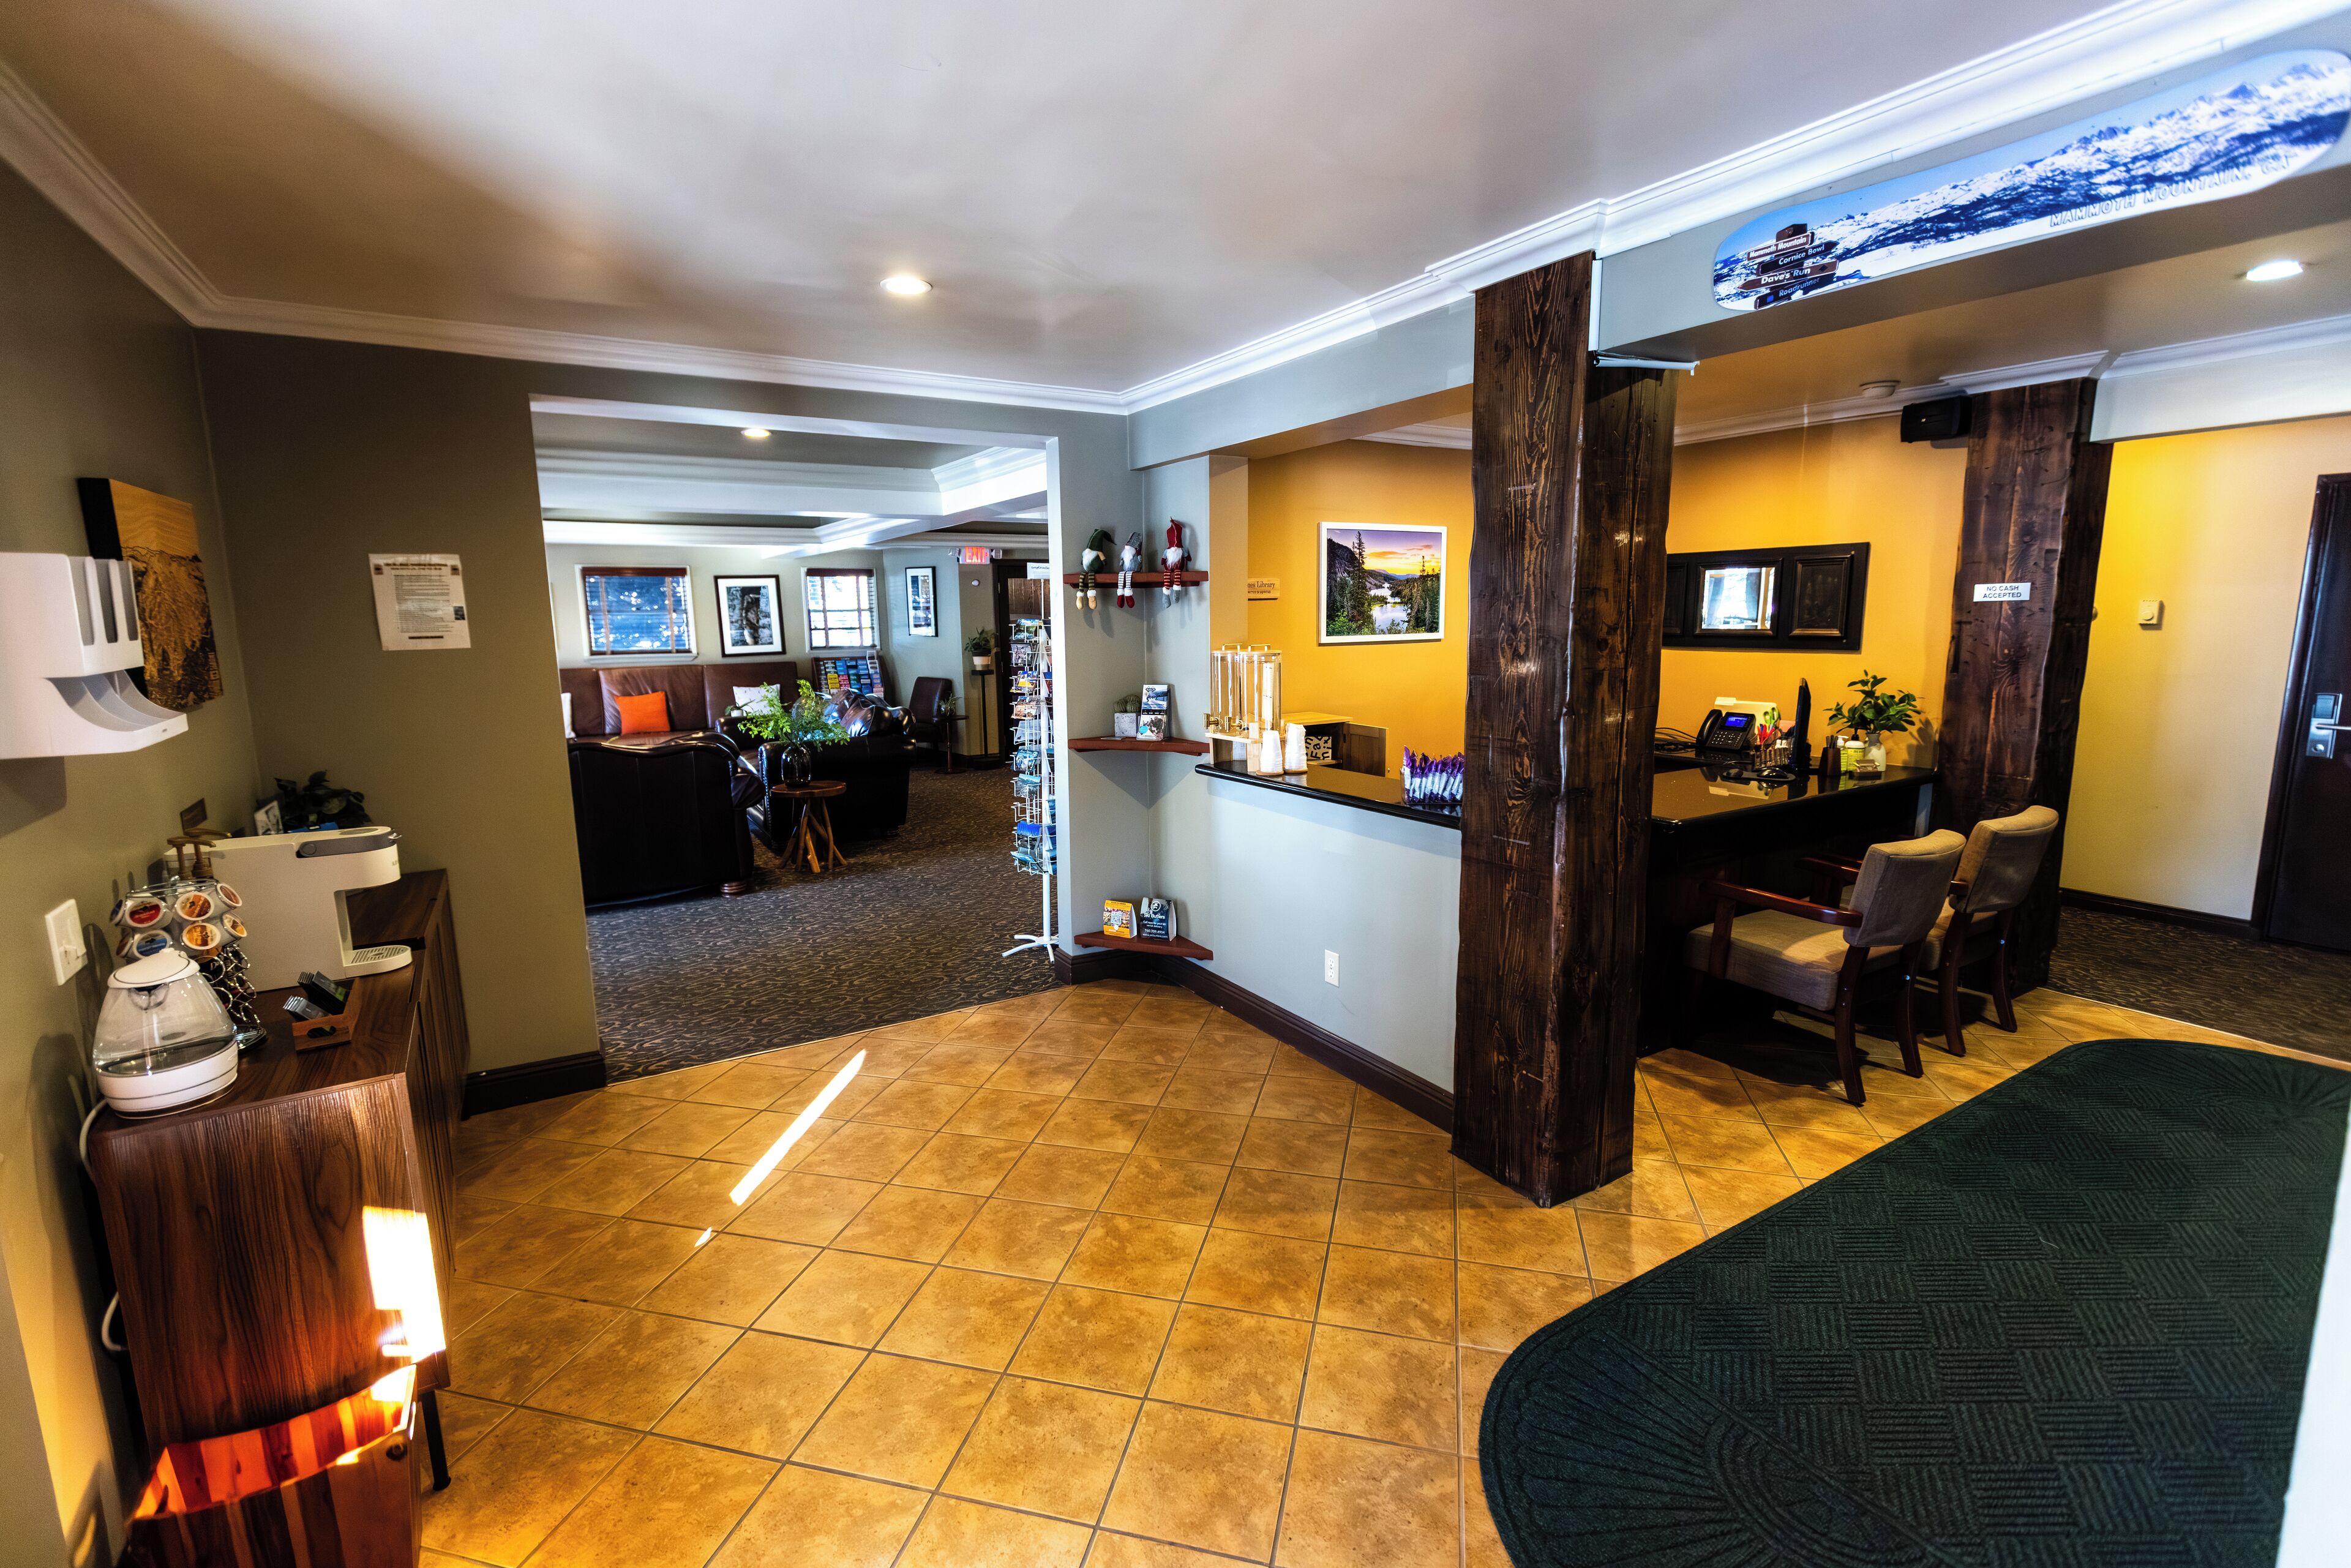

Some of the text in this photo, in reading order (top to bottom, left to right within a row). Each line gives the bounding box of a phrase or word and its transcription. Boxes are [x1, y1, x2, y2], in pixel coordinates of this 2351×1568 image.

[2050, 194, 2136, 227] MAMMOTH
[1749, 236, 1807, 258] Mammoth Mountain
[1779, 244, 1824, 265] Cornice Bowl
[1761, 268, 1810, 285] Dave's Run
[1779, 277, 1820, 297] Roadrunner
[965, 547, 986, 563] EXIT
